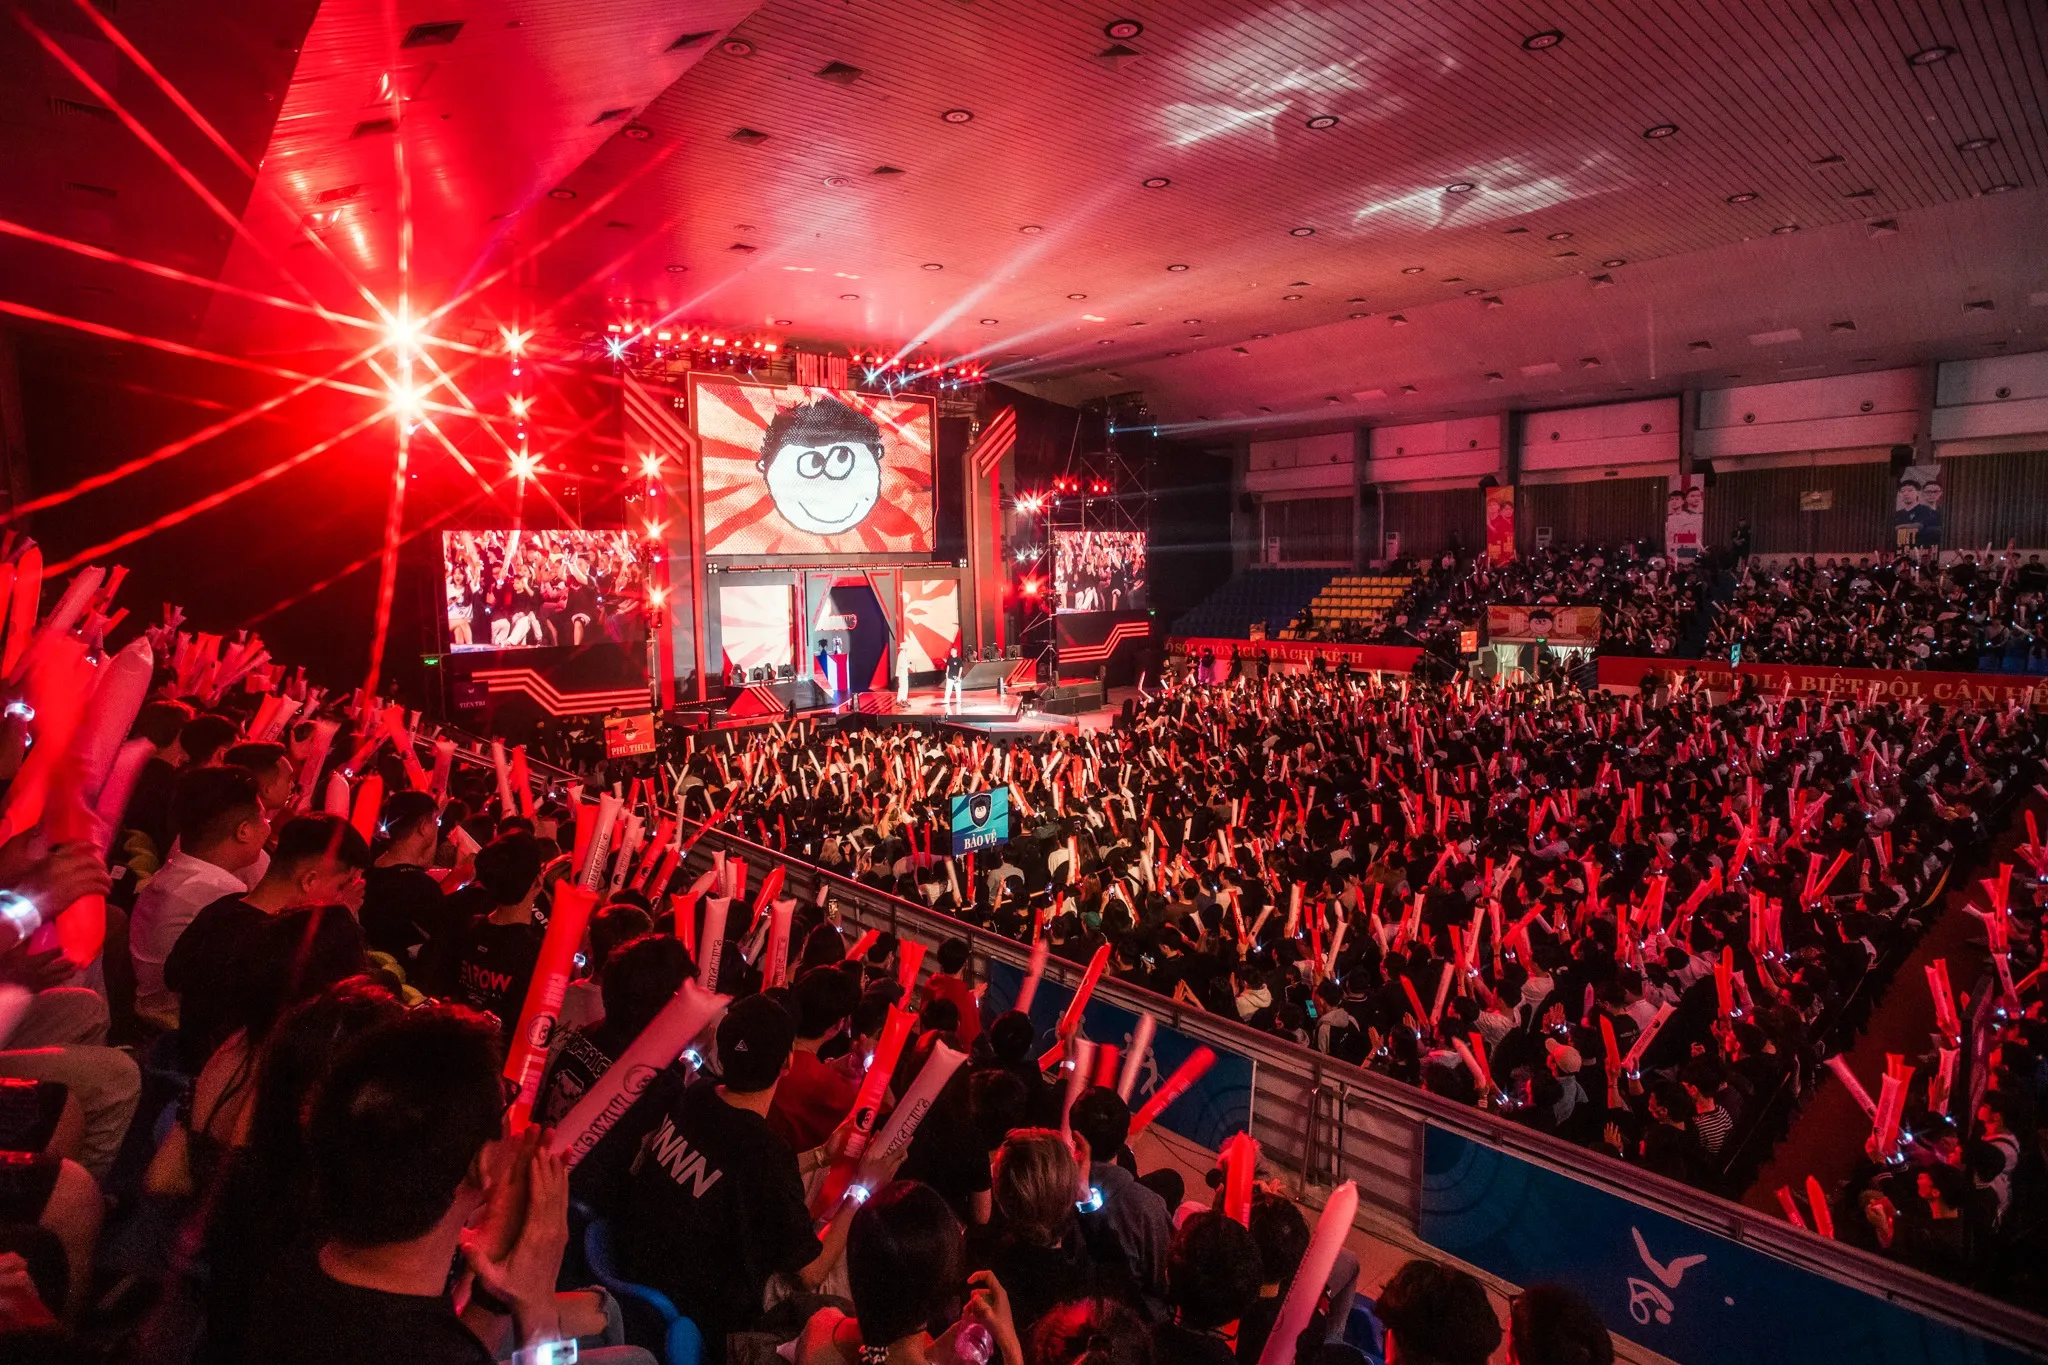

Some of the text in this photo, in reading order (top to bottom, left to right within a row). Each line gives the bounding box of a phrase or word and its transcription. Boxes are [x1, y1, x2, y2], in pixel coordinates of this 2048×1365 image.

[1270, 644, 1287, 660] BÀ
[1801, 672, 1864, 697] BIỆT
[1933, 679, 1998, 702] CÂN
[984, 828, 997, 846] VỆ
